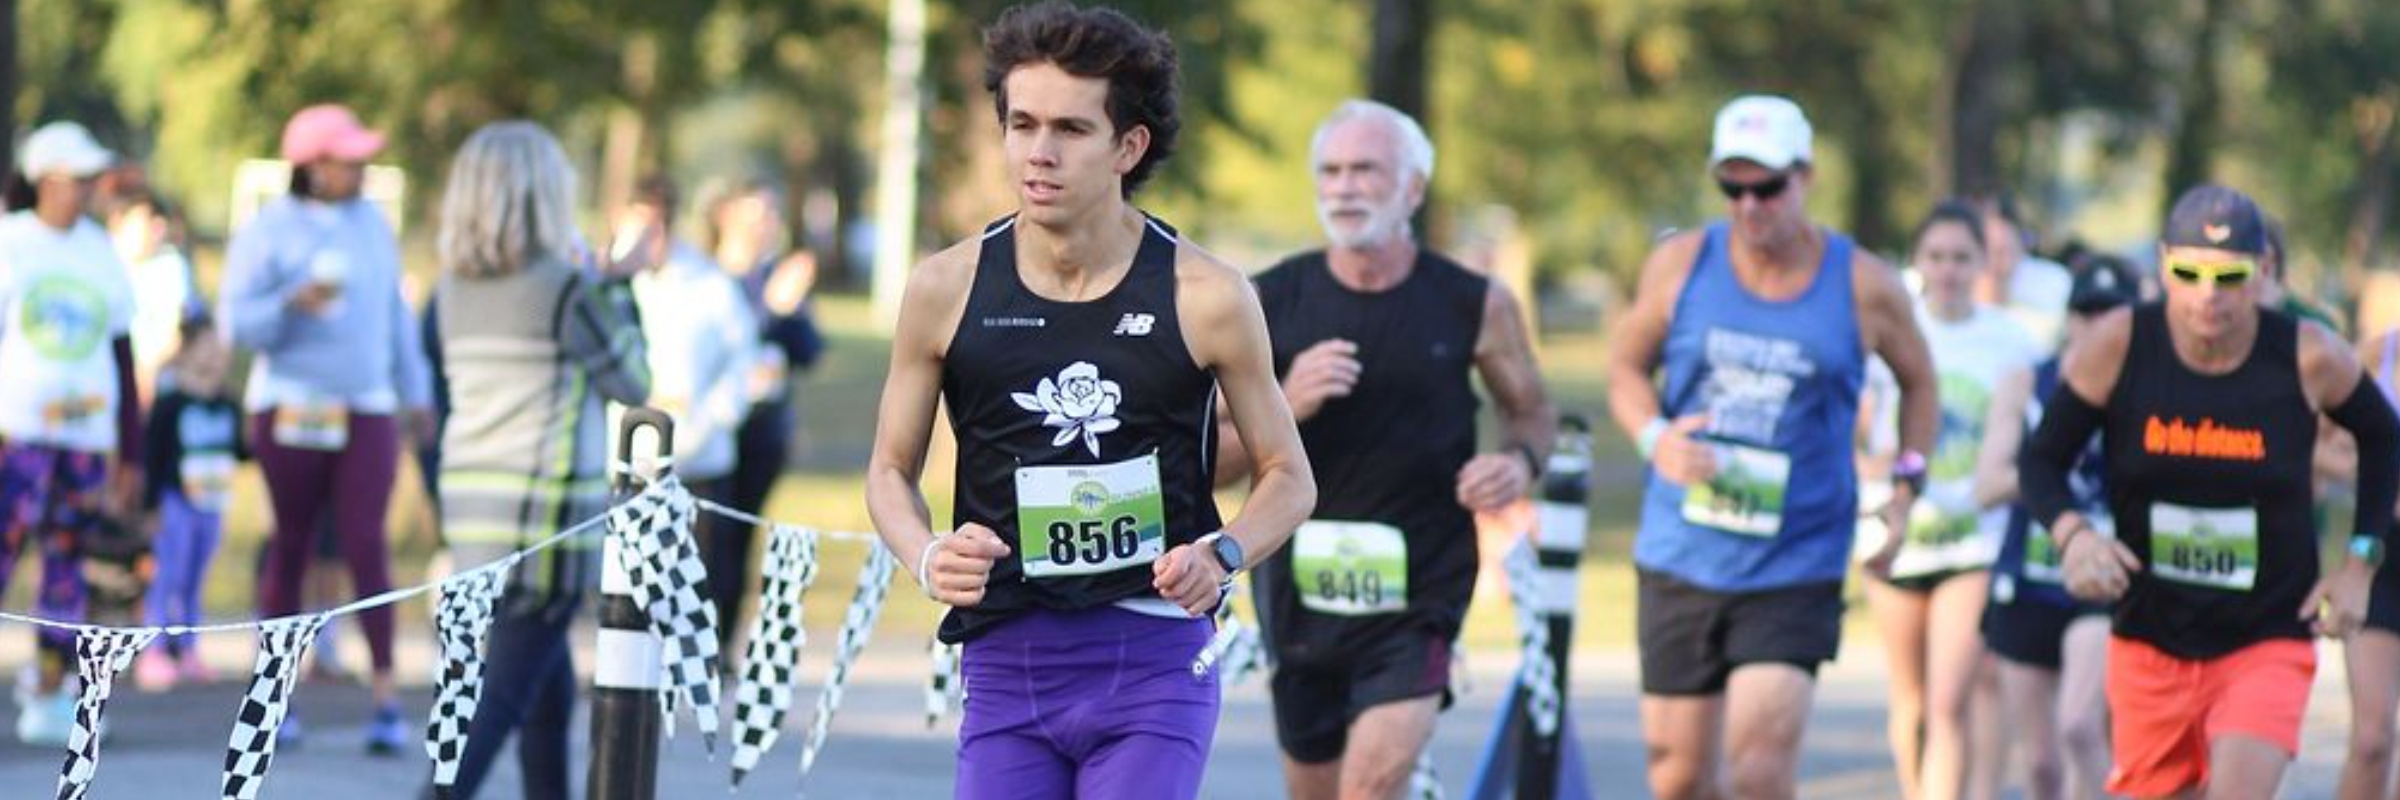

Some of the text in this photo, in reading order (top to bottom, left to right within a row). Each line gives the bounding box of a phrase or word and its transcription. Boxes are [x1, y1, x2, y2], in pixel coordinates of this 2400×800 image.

[1113, 313, 1156, 336] NB
[2167, 416, 2194, 456] the
[1048, 515, 1139, 566] 856
[2172, 543, 2236, 576] 850
[1317, 568, 1382, 606] 849
